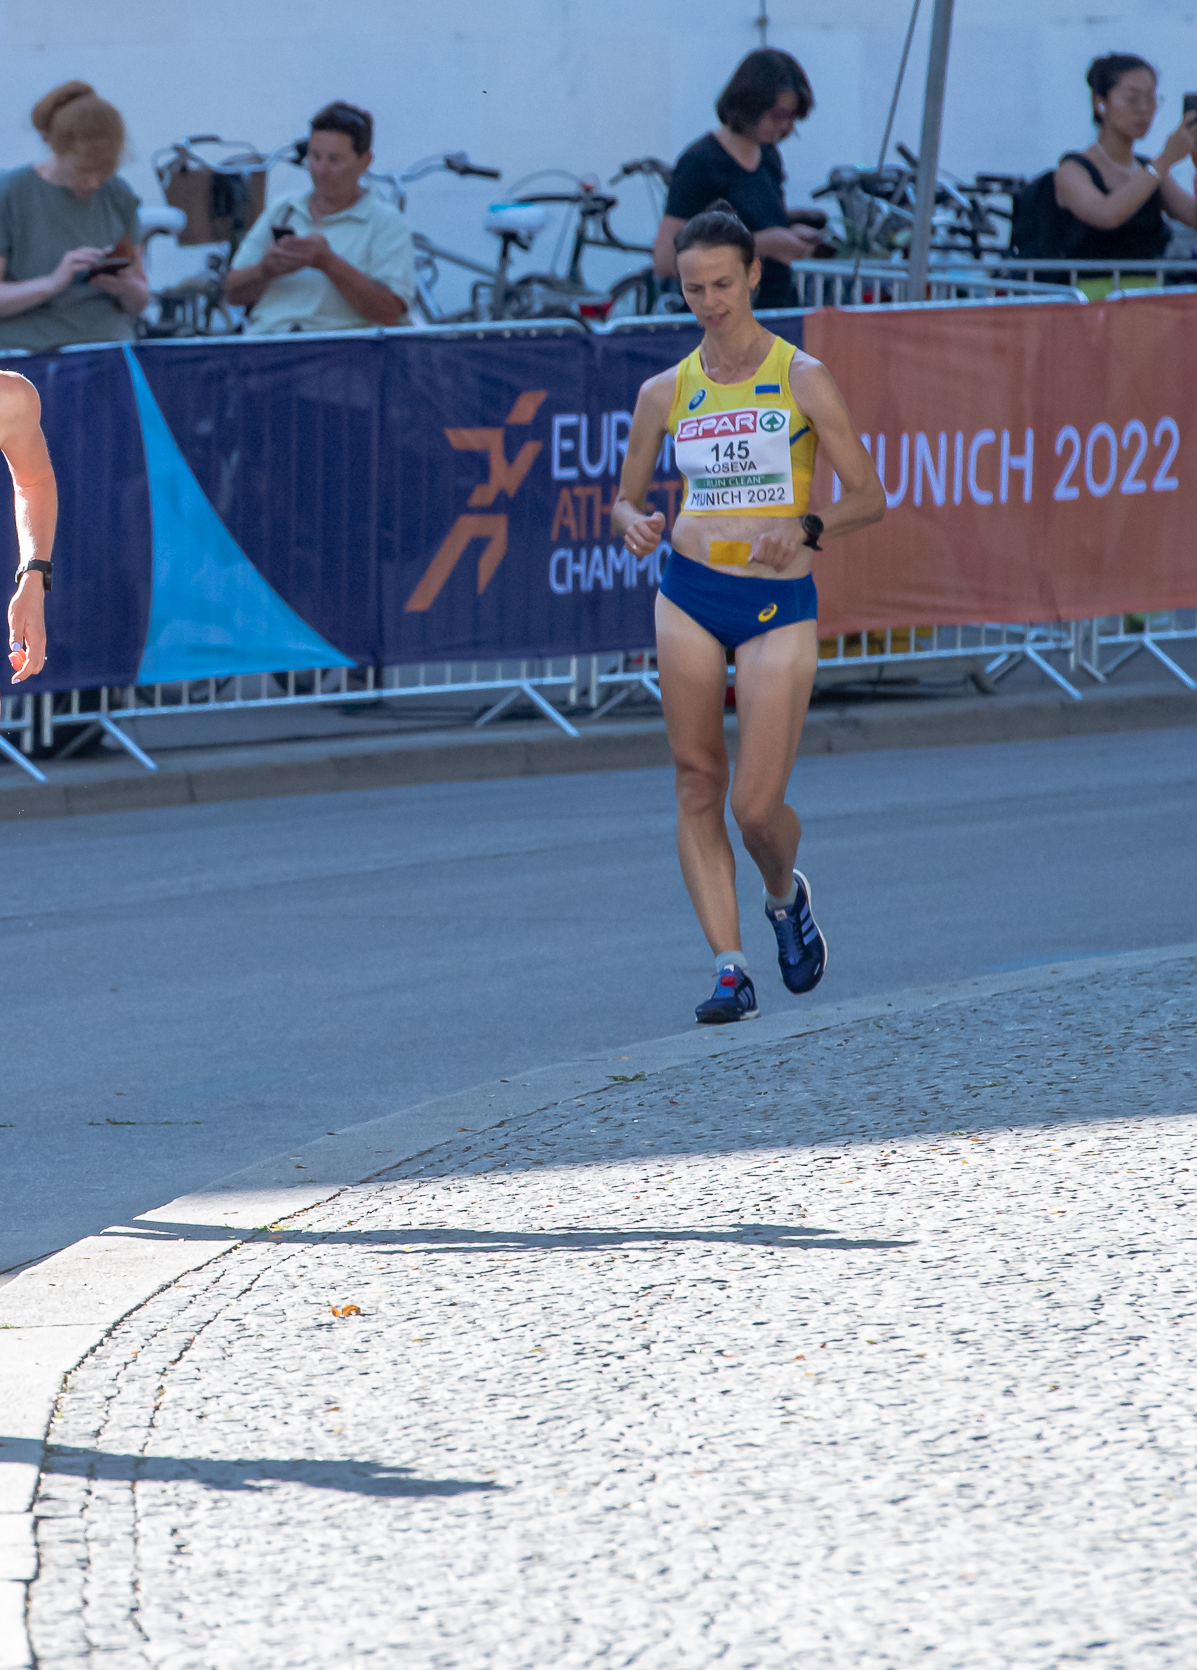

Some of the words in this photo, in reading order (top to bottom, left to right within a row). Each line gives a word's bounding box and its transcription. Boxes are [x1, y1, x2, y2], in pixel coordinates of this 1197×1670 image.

[680, 412, 755, 439] SPAR
[711, 440, 750, 462] 145
[1053, 416, 1180, 501] 2022
[691, 491, 741, 506] MUNICH
[747, 487, 785, 503] 2022
